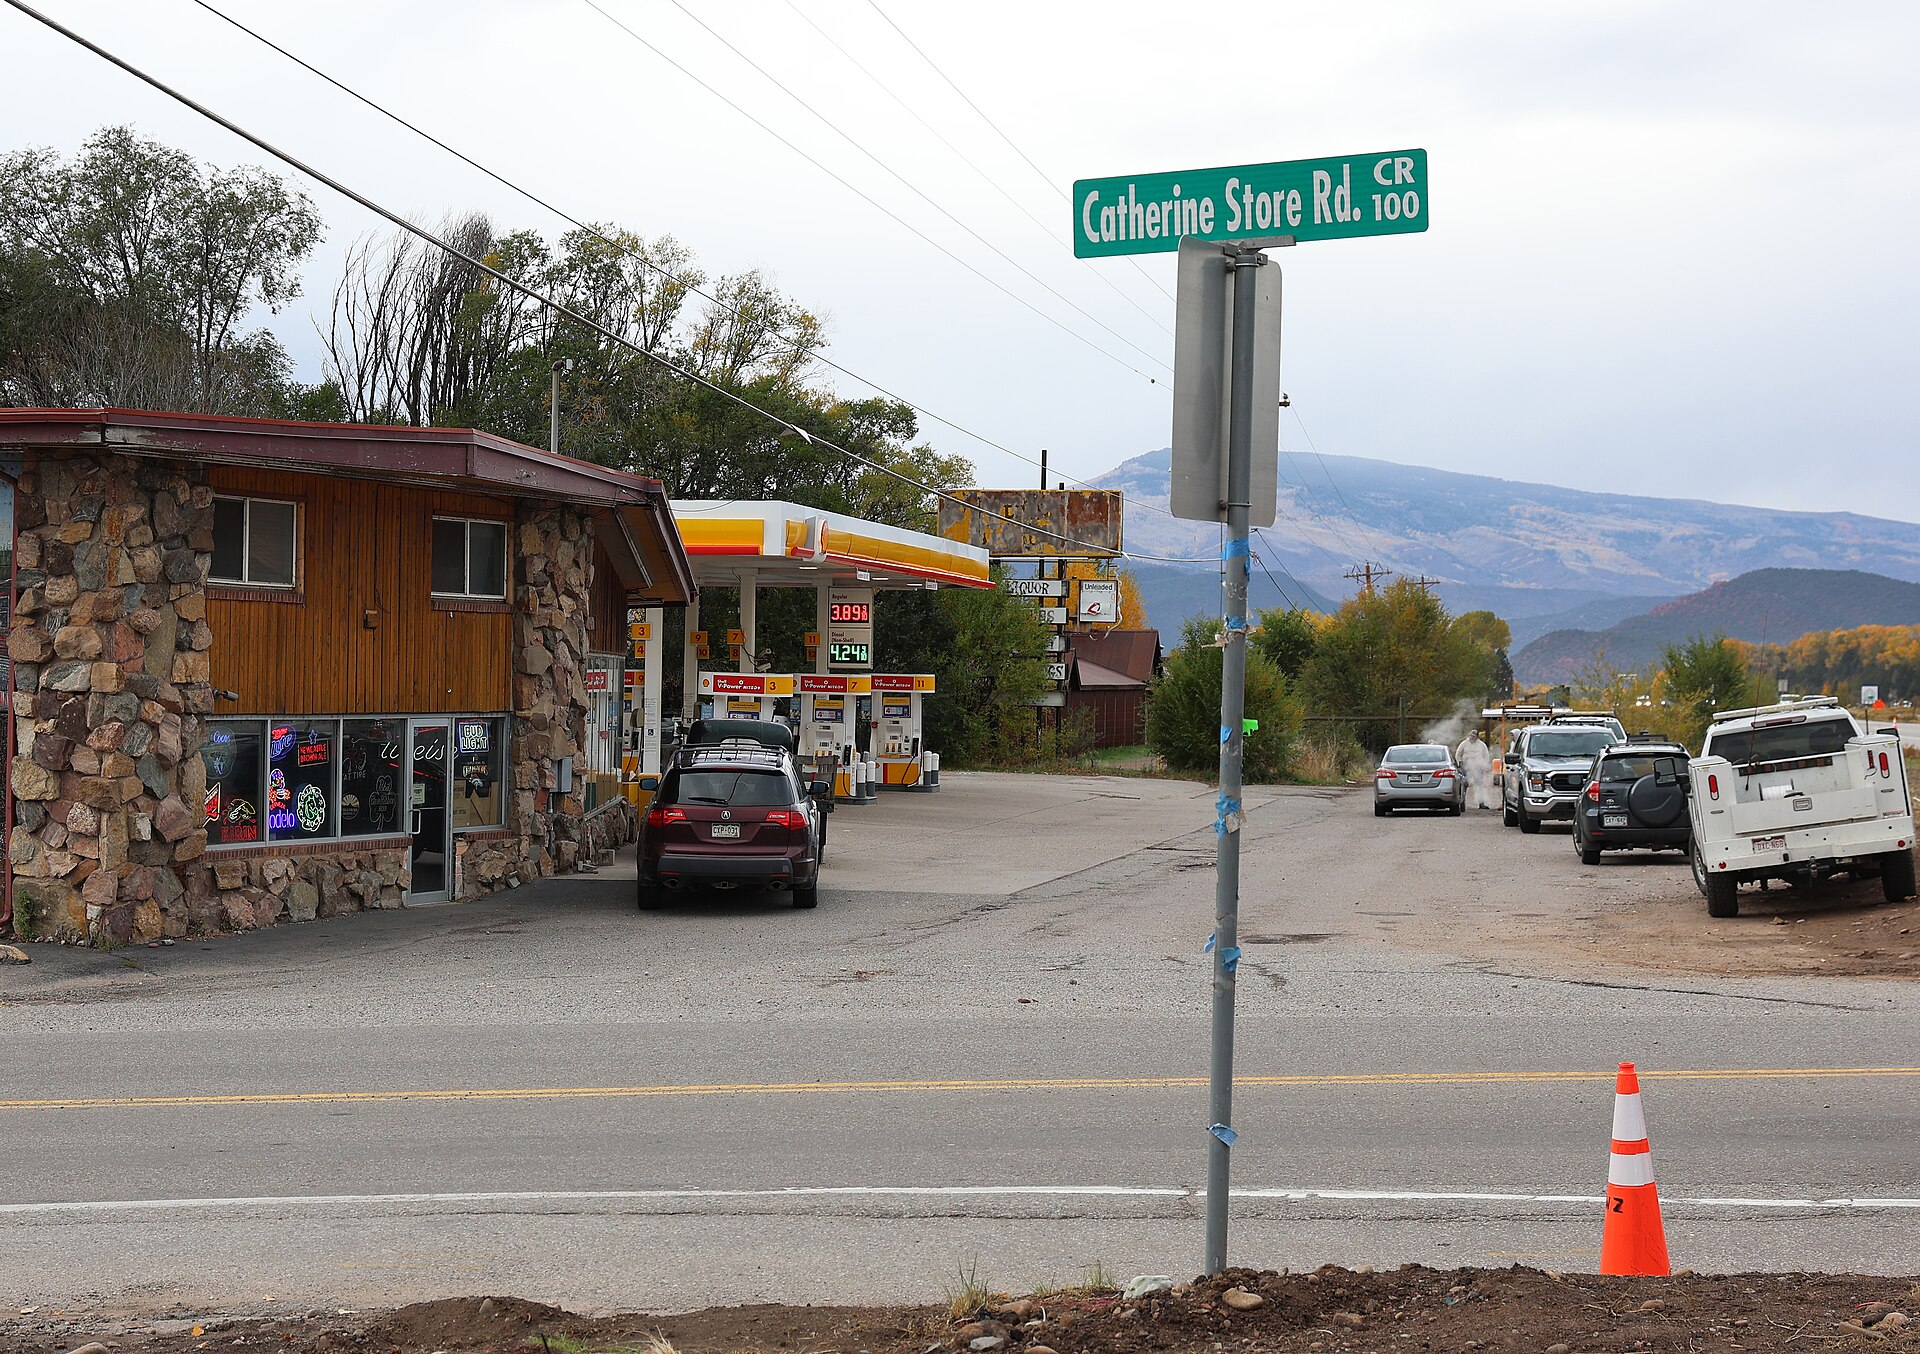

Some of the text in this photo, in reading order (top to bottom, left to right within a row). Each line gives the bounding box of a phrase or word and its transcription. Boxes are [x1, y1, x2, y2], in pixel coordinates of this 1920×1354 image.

[1374, 157, 1415, 186] CR
[1083, 164, 1361, 243] Catherine Store Rd.
[1371, 191, 1420, 221] 100
[831, 604, 860, 620] 3.89
[638, 626, 645, 636] 3
[637, 645, 644, 654] 4
[830, 644, 860, 660] 4.24
[770, 682, 776, 690] 3
[917, 680, 924, 688] 11
[464, 725, 483, 737] BUD
[462, 736, 488, 750] LIGHT
[268, 809, 294, 828] odelo
[221, 826, 257, 841] KIRIN
